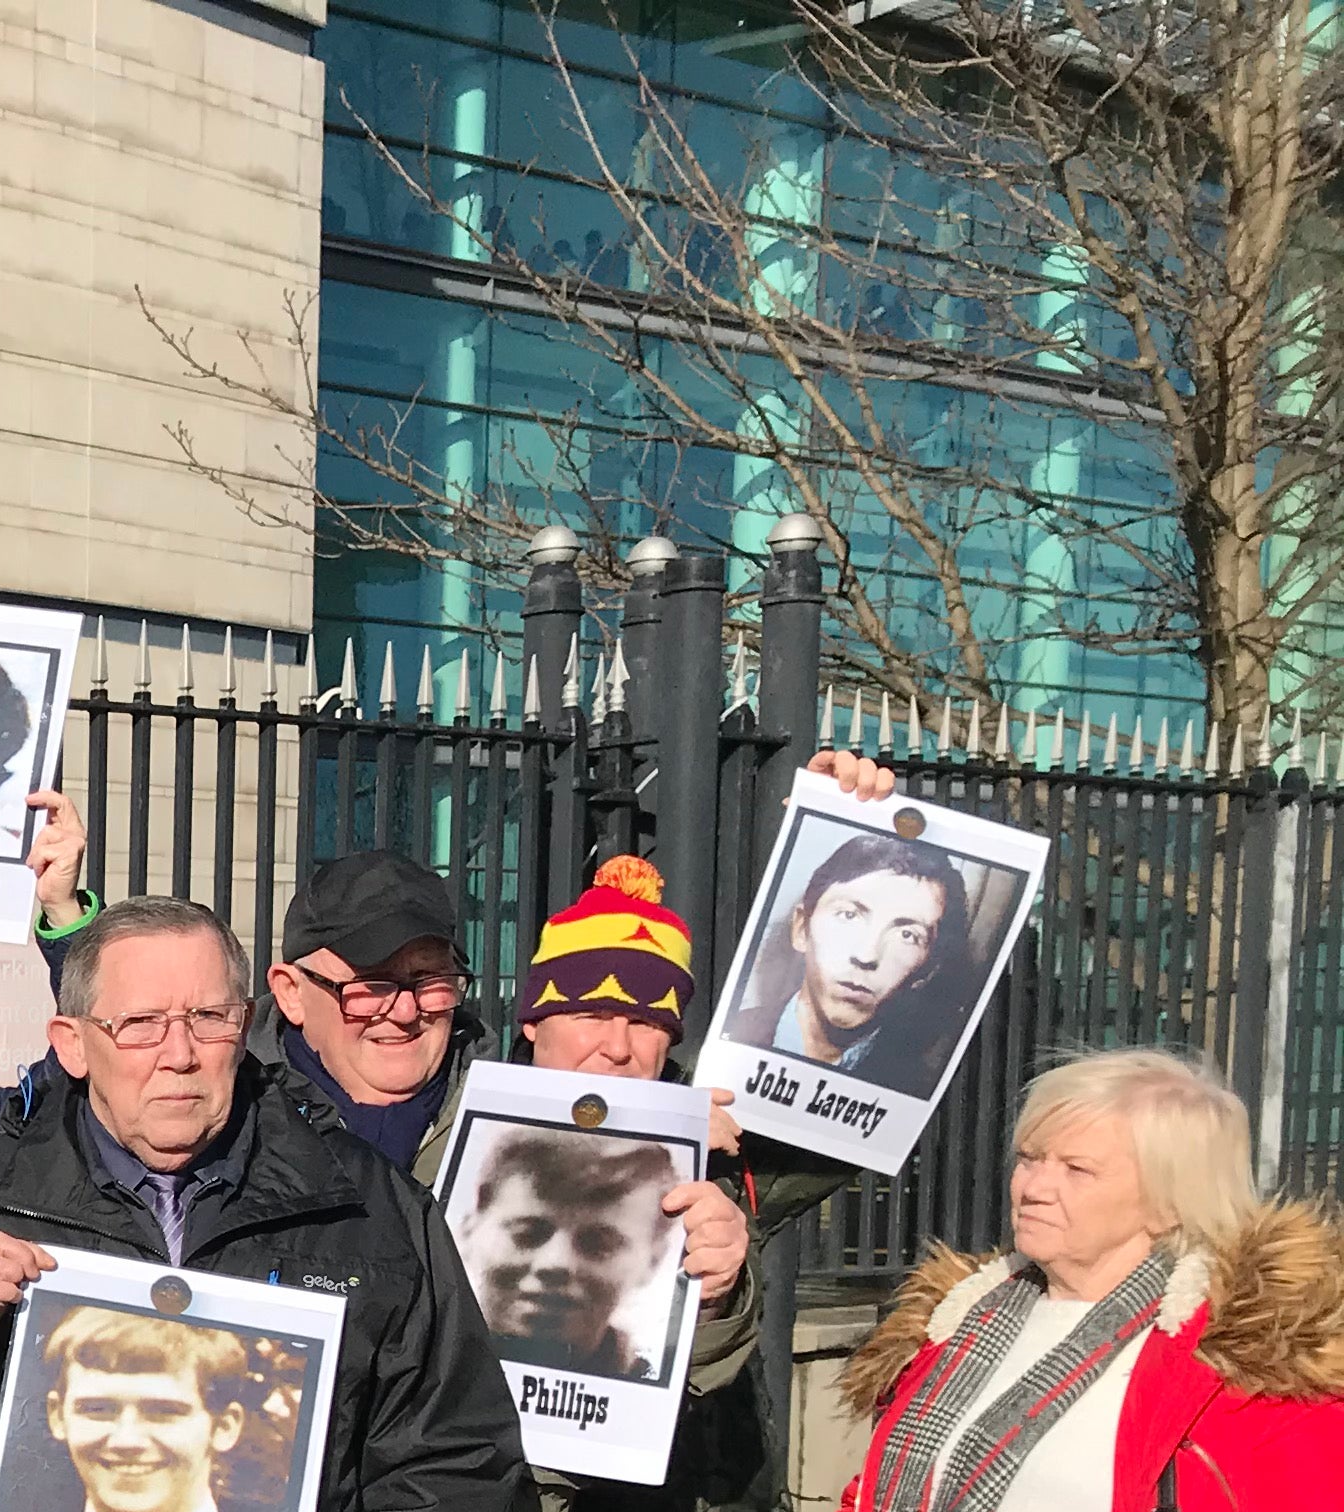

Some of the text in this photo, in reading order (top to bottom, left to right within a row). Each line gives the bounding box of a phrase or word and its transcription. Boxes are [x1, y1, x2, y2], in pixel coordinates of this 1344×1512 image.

[745, 1060, 888, 1139] John Laverty
[302, 1274, 348, 1294] gelert
[519, 1375, 610, 1431] Phillips
